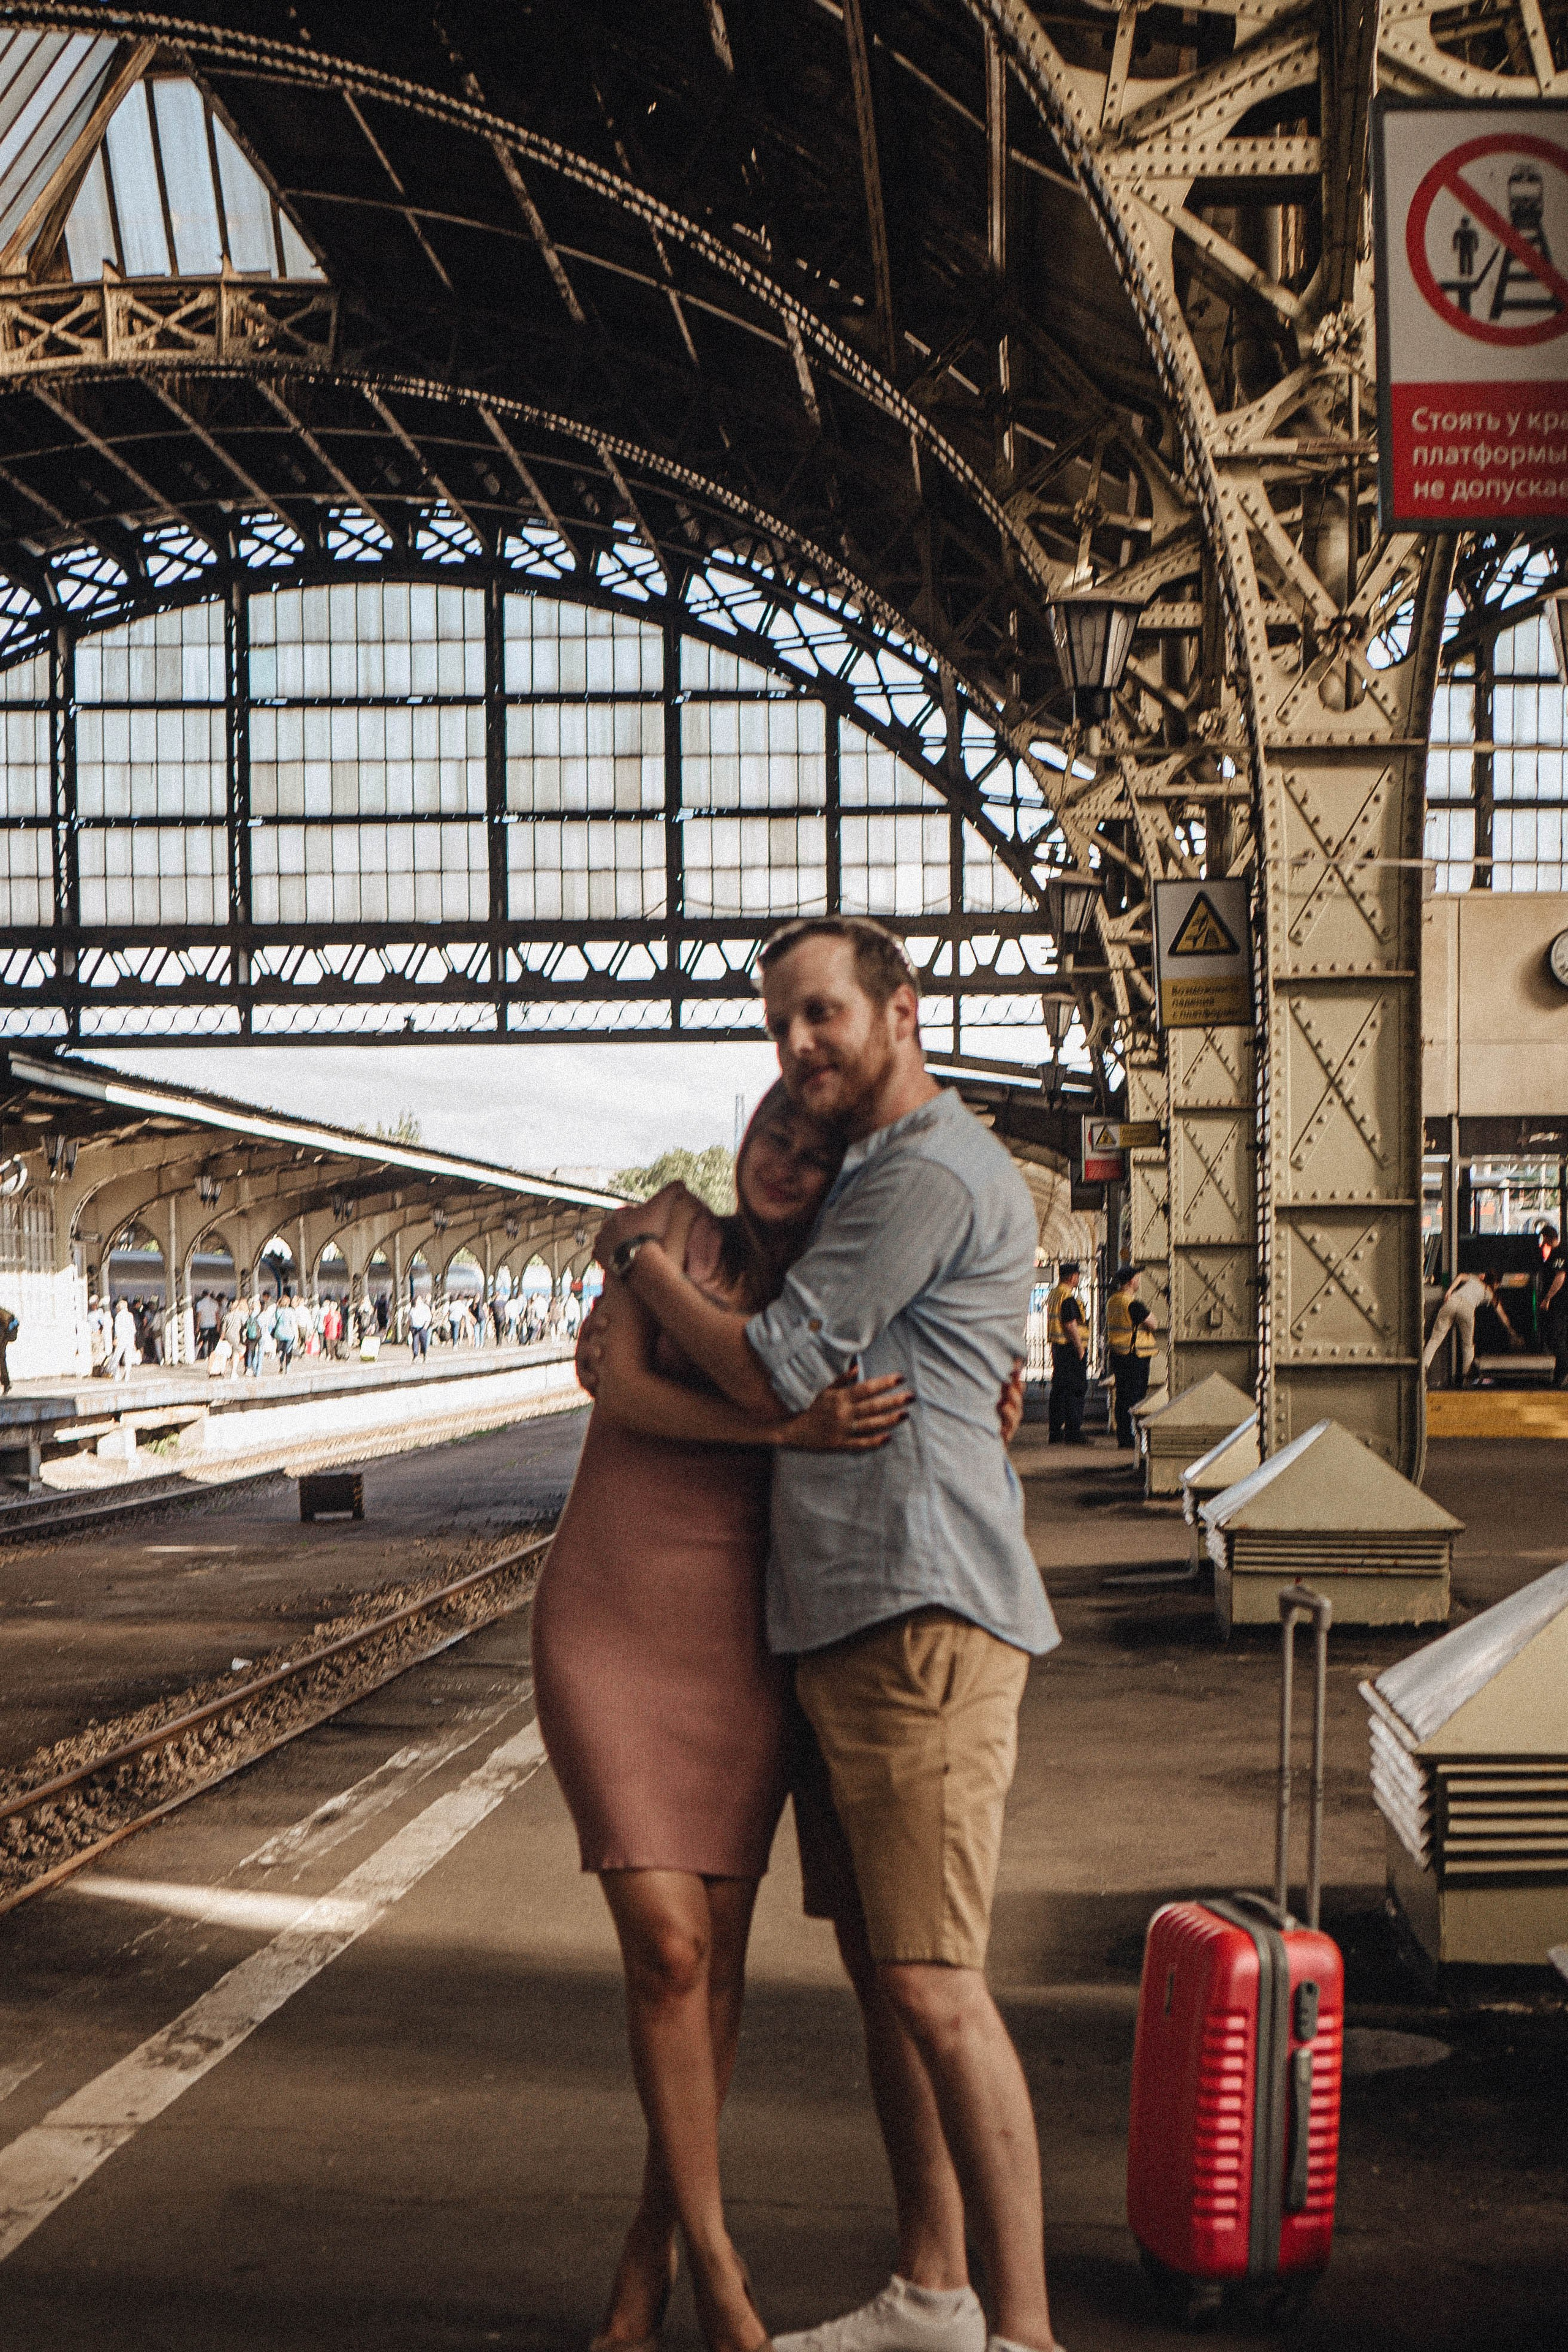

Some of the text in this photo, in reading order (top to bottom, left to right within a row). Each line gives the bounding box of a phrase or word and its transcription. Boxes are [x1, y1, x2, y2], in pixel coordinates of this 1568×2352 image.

[1411, 406, 1501, 432] Стоять
[1506, 411, 1521, 437] у
[1412, 440, 1567, 471] платформы
[1413, 479, 1446, 500] не
